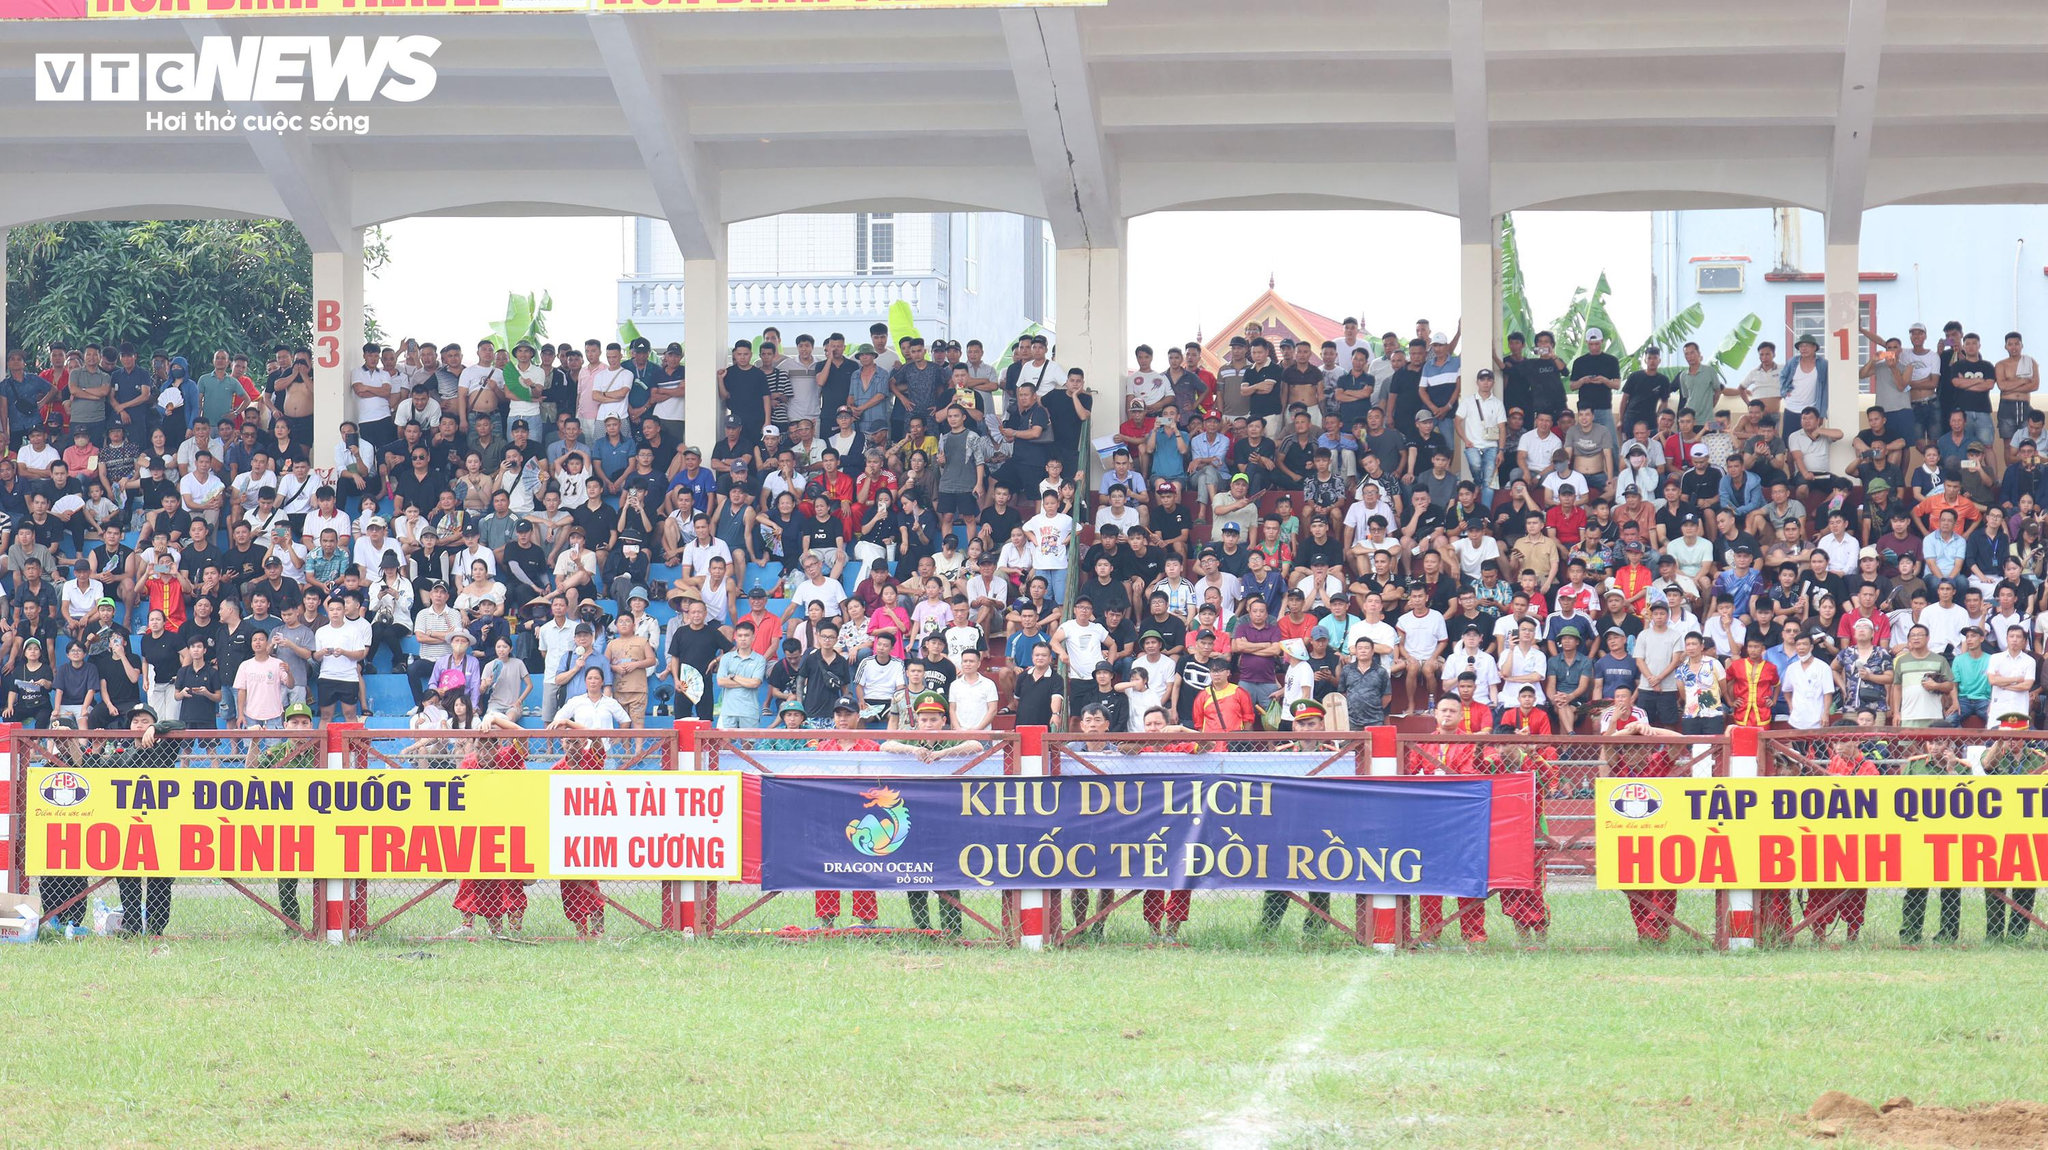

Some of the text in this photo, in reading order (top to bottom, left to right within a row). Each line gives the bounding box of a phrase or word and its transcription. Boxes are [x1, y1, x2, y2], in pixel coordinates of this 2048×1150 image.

[111, 774, 471, 815] TẬP ĐOÀN QUỐC TẾ
[564, 781, 725, 823] NHÀ TÀI TRỢ
[960, 780, 1273, 825] KHU DU LỊCH
[1685, 784, 1758, 826] TẬP
[1771, 783, 1878, 820] ĐOÀN
[1894, 780, 2002, 822] QUỐC
[46, 816, 535, 873] HOÀ BÌNH TRAVEL
[564, 833, 725, 869] KIM CƯƠNG
[958, 826, 1422, 886] QUỐC TẾ ĐỒI RỒNG
[1617, 827, 1737, 884] HOÀ
[1759, 826, 1902, 883] BÌNH
[823, 862, 934, 873] DRAGON OCEAN
